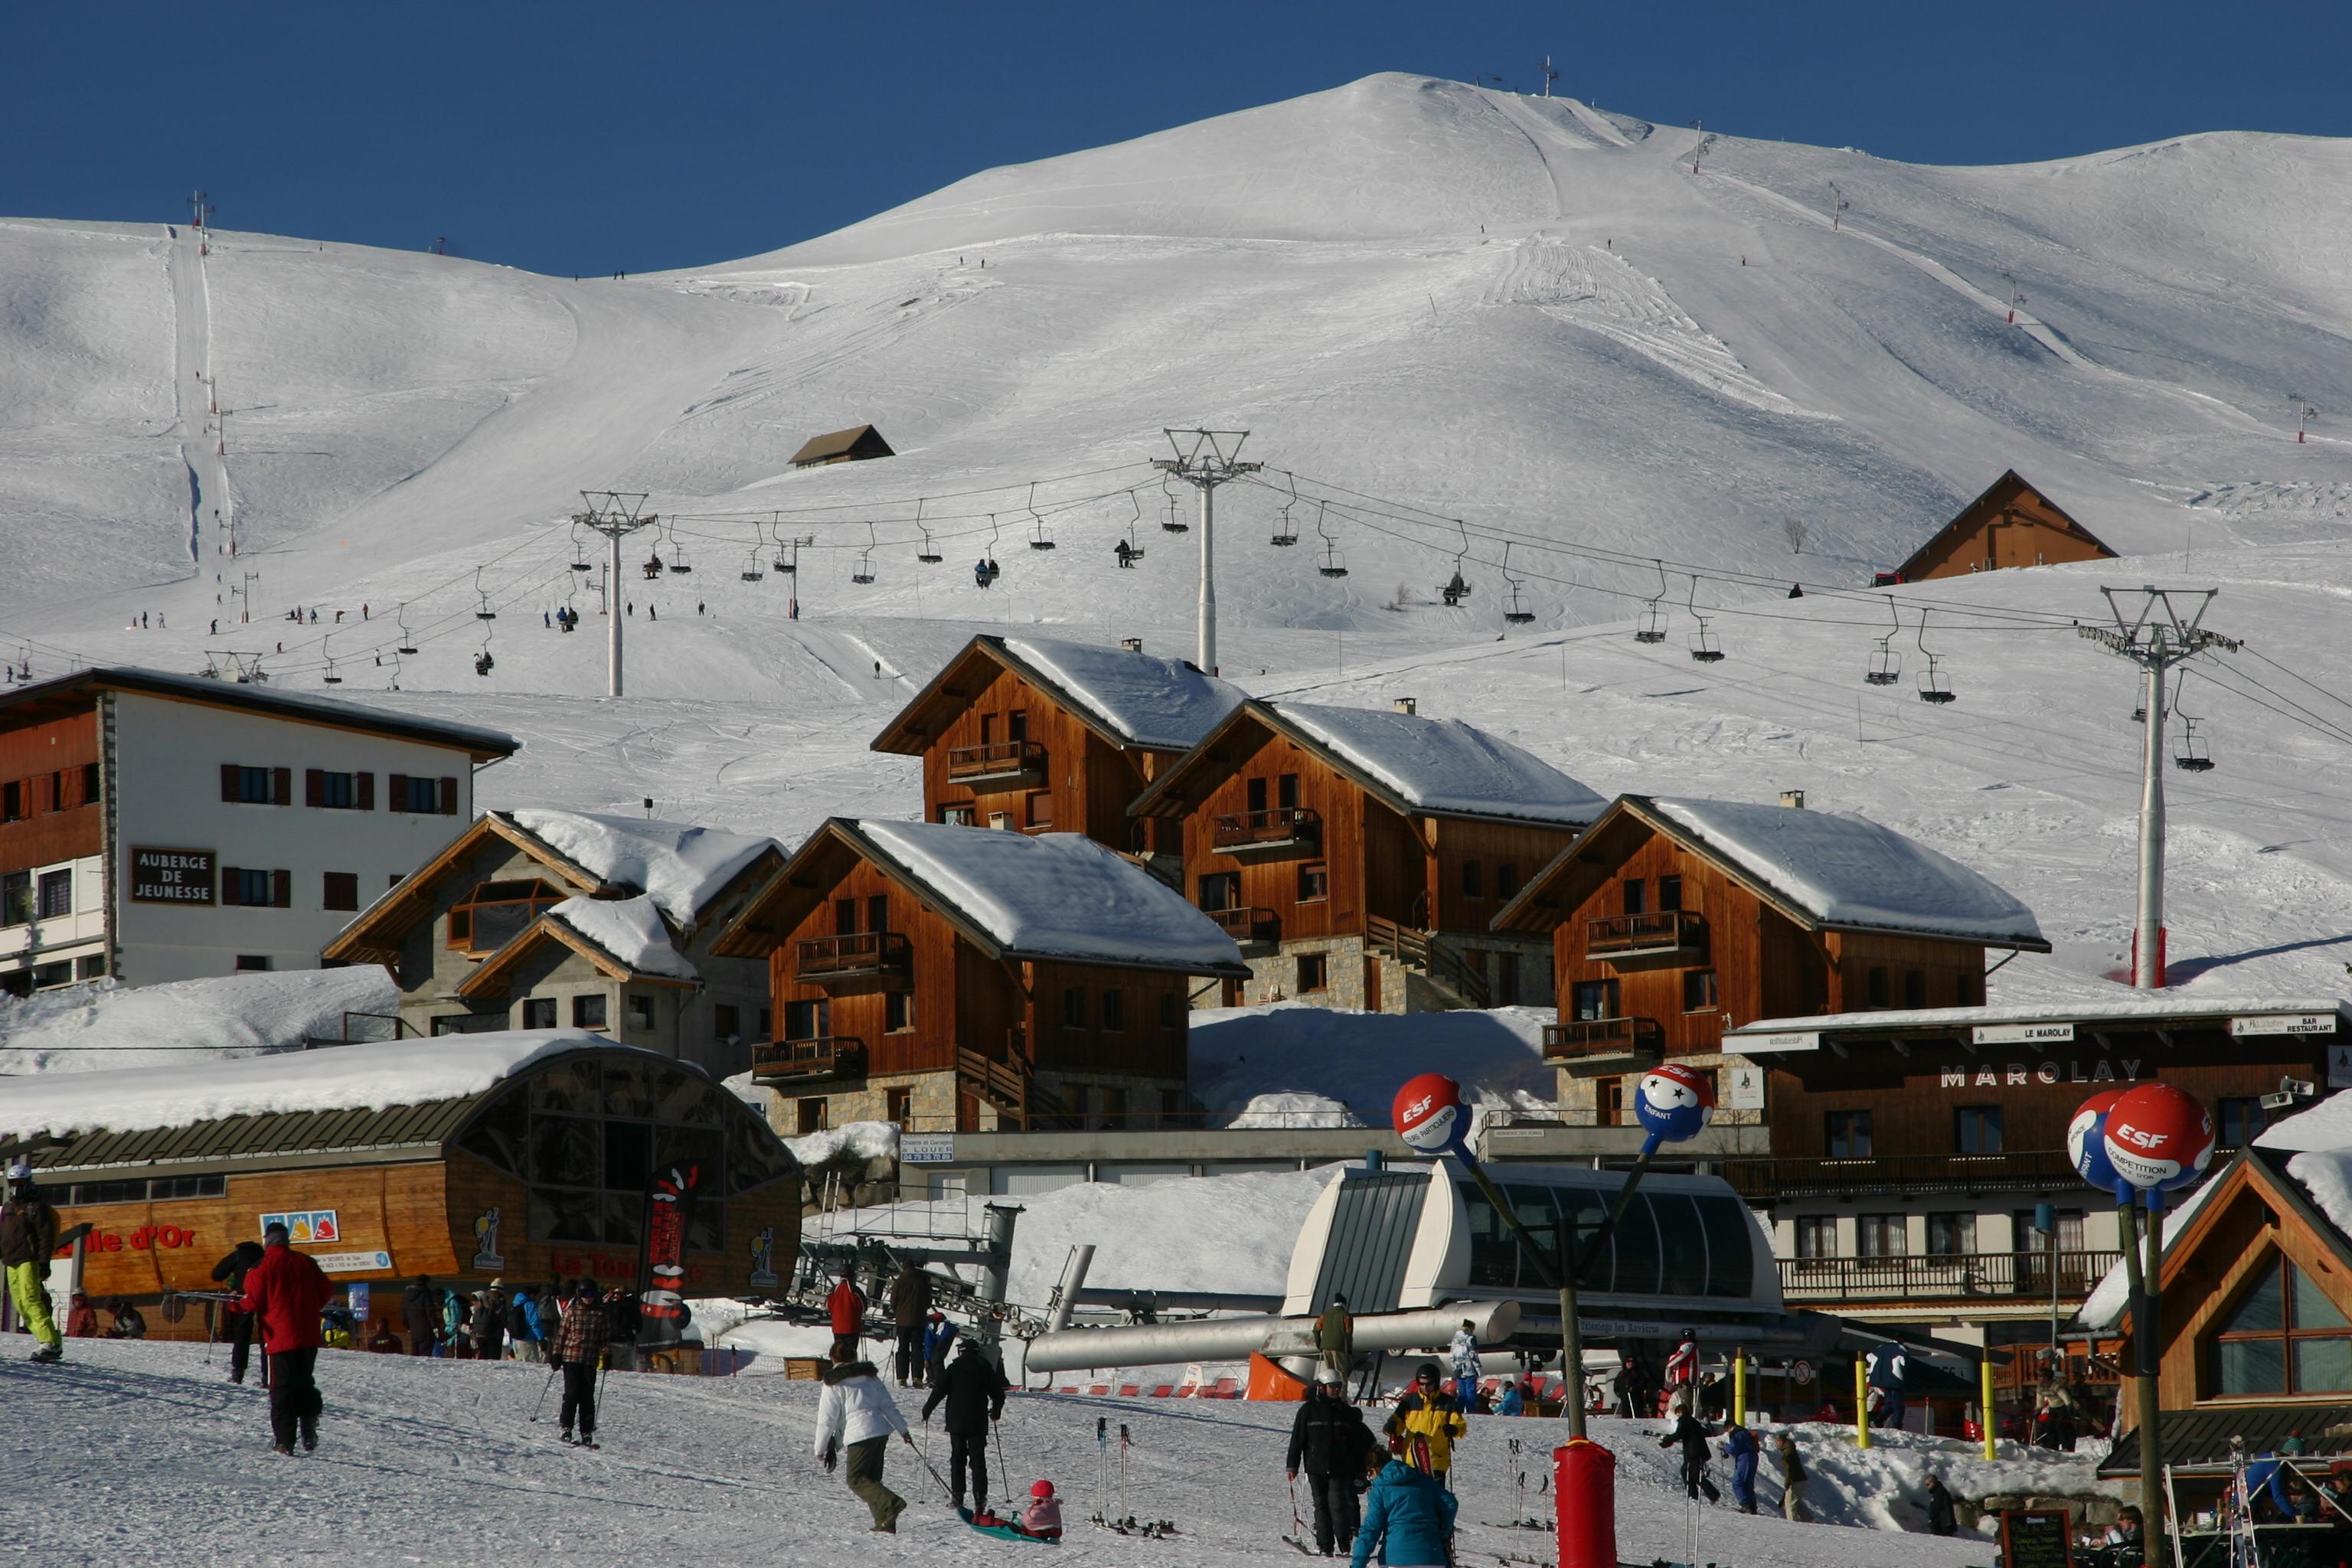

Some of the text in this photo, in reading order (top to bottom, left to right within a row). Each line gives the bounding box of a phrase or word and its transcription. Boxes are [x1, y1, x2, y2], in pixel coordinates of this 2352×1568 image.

[139, 853, 207, 870] AUBERGE
[161, 870, 183, 884] DE
[135, 884, 209, 900] JEUNESSE
[2037, 1028, 2071, 1037] MAROLAY
[2286, 1024, 2333, 1033] RESTAURANT
[1658, 1065, 1696, 1079] ESF
[1940, 1059, 2141, 1088] MAROLAY
[1403, 1094, 1432, 1124] ESF
[1644, 1104, 1672, 1120] ENFANT
[2116, 1123, 2168, 1149] ESF
[2108, 1147, 2167, 1174] COMPETITION
[130, 1225, 196, 1250] d'Or
